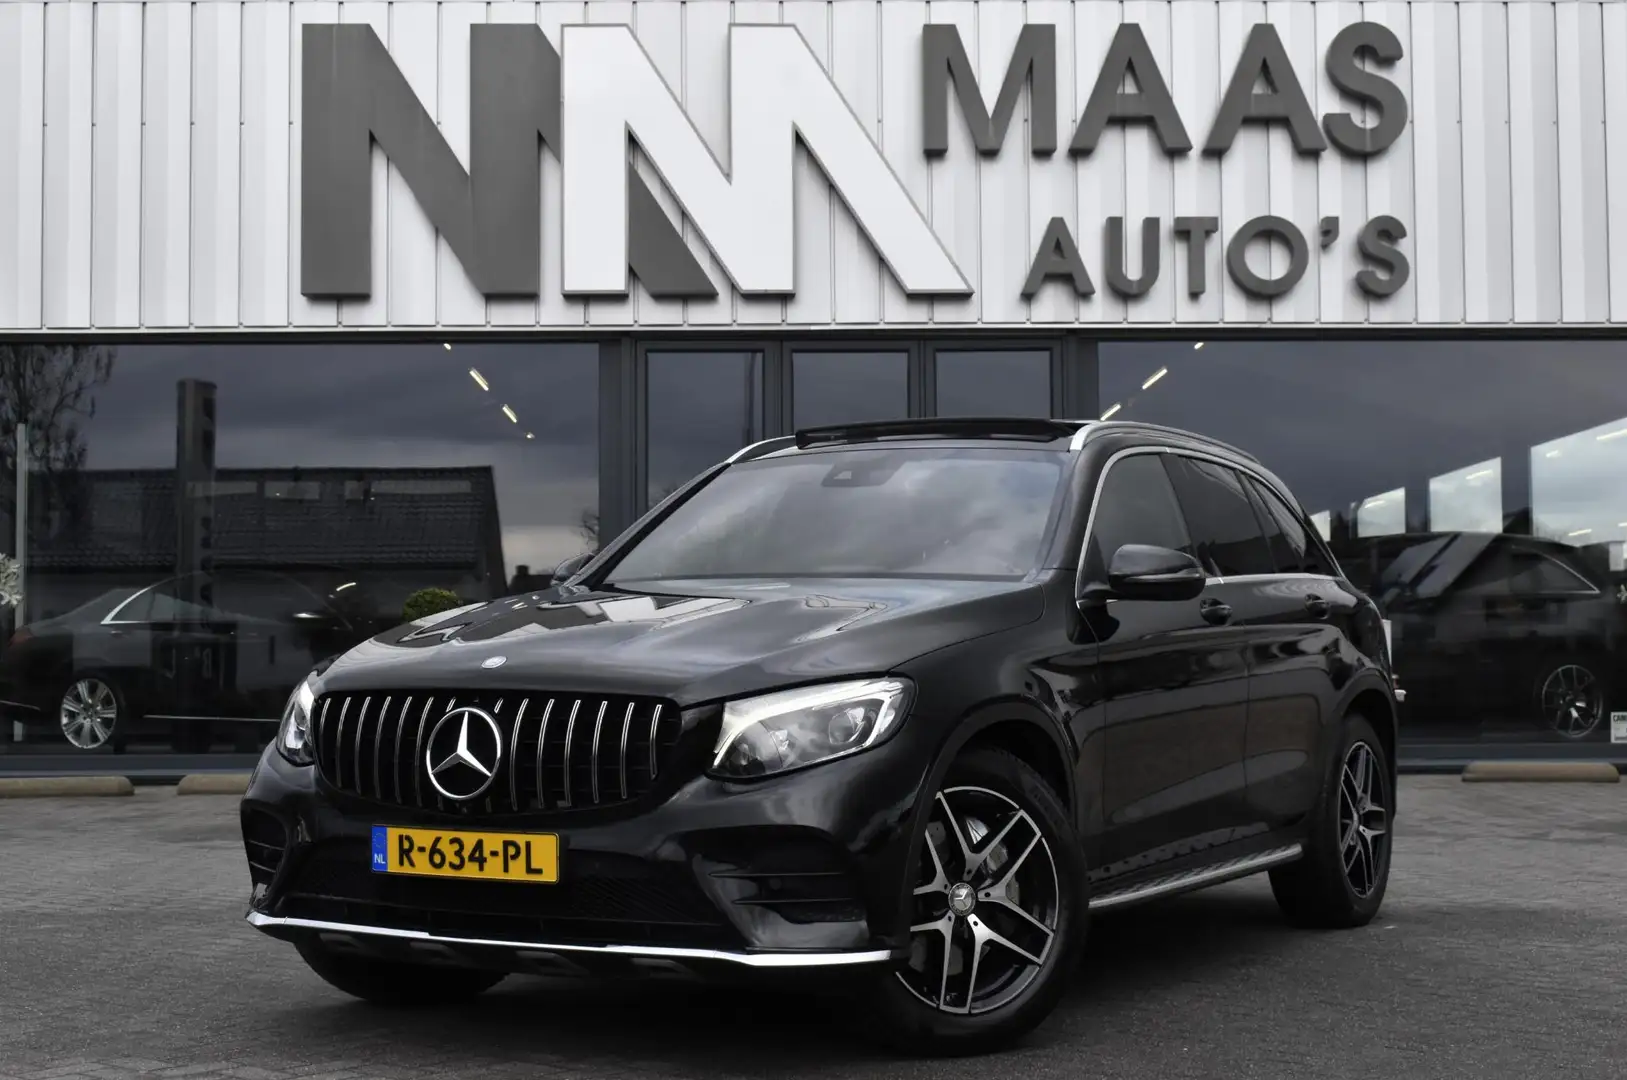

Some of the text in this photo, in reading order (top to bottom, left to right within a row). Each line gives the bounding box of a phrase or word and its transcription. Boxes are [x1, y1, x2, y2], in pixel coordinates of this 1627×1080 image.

[922, 21, 1408, 157] MAAS
[1020, 215, 1410, 298] AUTO'S
[373, 853, 386, 865] NL
[398, 833, 543, 875] R-634-PL
